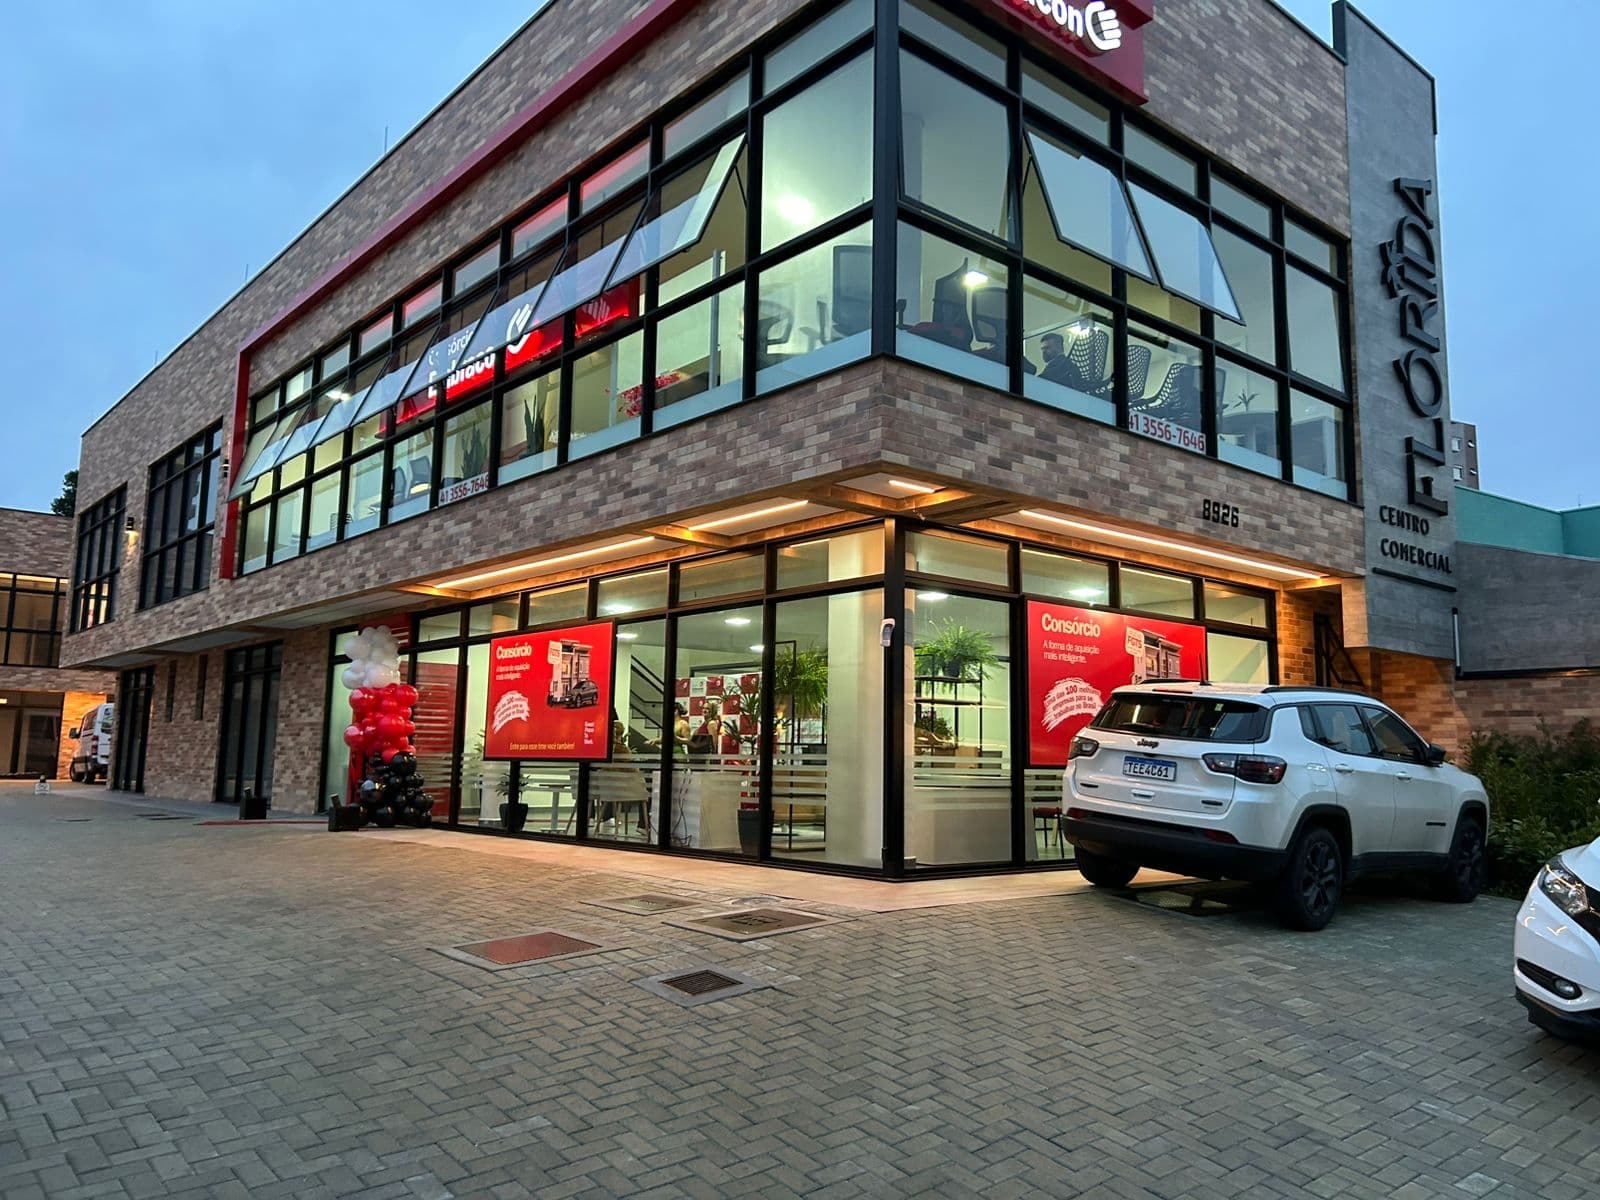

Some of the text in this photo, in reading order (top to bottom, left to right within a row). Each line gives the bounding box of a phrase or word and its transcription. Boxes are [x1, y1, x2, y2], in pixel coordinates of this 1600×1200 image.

[1142, 415, 1205, 452] 3556-7646
[1202, 498, 1240, 528] 8926
[1379, 504, 1430, 536] CENTRO
[1380, 537, 1453, 575] COMERCIAL
[1041, 612, 1101, 638] Consórcio
[1066, 684, 1078, 695] 100
[1128, 762, 1169, 778] TEE4C61
